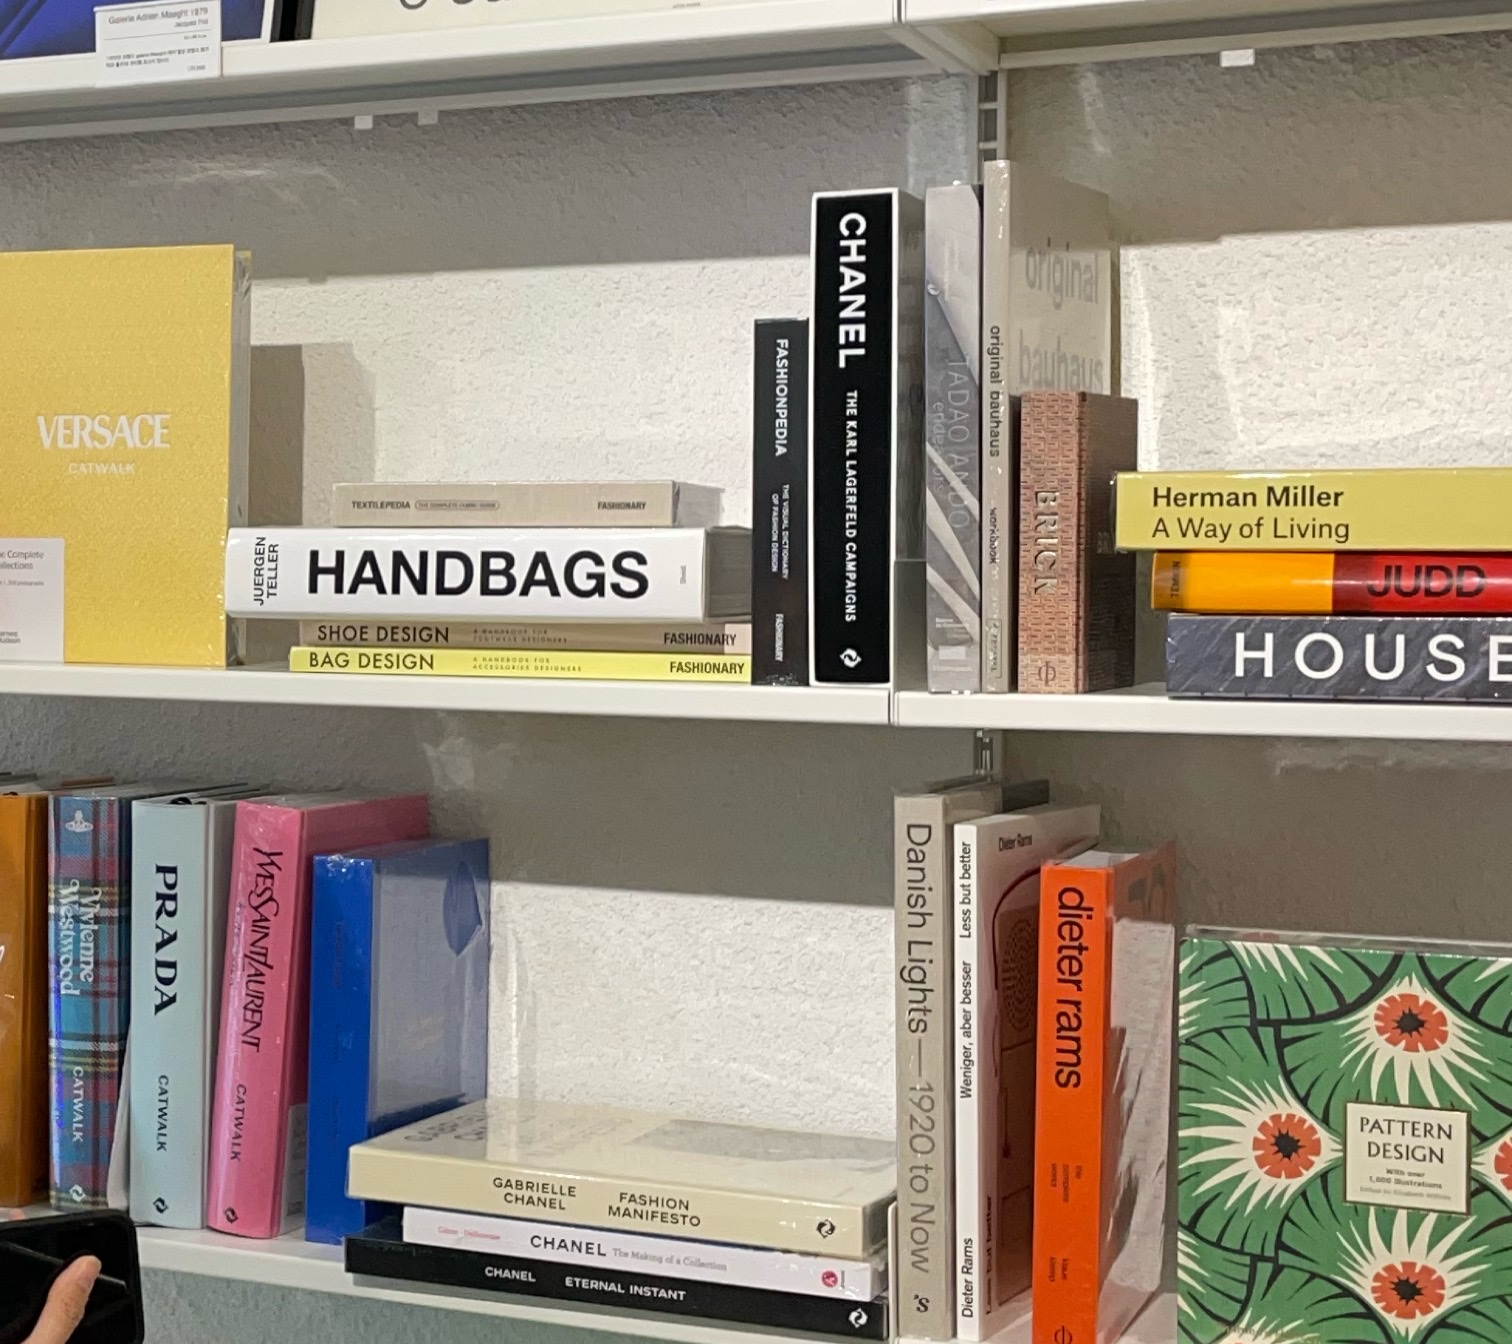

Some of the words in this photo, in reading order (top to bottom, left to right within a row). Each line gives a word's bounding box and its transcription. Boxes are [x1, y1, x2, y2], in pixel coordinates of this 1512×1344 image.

[838, 211, 867, 369] CHANEL
[989, 325, 1004, 384] original
[775, 339, 789, 457] FASHIONPEDIA
[846, 390, 858, 416] THE
[37, 413, 172, 449] VERSACE
[846, 420, 858, 457] KARL
[989, 390, 1001, 458] bauhaus
[68, 462, 136, 475] CATWALK
[352, 500, 411, 510] TEXTILEPEDIA
[598, 501, 647, 510] FASHIONARY
[845, 461, 858, 538] LAGERFELD
[1152, 486, 1257, 508] Herman
[1267, 485, 1344, 508] Miller
[1034, 490, 1060, 596] BRICK
[1152, 518, 1170, 538] A
[1177, 518, 1232, 543] Way
[1239, 517, 1264, 538] of
[1273, 517, 1350, 543] Living
[7, 549, 45, 561] Complete
[253, 536, 267, 606] JUERGEN
[267, 543, 279, 599] TELLER
[308, 549, 649, 599] HANDBAGS
[844, 543, 857, 622] CAMPAIGNS
[1367, 564, 1486, 598] JUDD
[317, 625, 369, 642] SHOE
[377, 626, 449, 643] DESIGN
[664, 632, 737, 647] FASHIONARY
[309, 651, 350, 669] BAG
[358, 653, 434, 671] DESIGN
[669, 661, 745, 674] FASHIONARY
[905, 823, 932, 929] Danish
[959, 841, 972, 880] better
[959, 883, 972, 905] but
[59, 878, 81, 996] Westwood
[79, 886, 102, 984] Vivienne
[154, 863, 179, 1017] PRADA
[959, 908, 972, 939] Less
[1057, 885, 1094, 991] dieter
[959, 961, 972, 1005] besser
[960, 1009, 972, 1039] aber
[1054, 998, 1082, 1089] rams
[959, 1042, 974, 1099] Weniger,
[71, 1065, 84, 1143] CATWALK
[156, 1074, 170, 1153] CATWALK
[231, 1083, 247, 1162] CATWALK
[1360, 1116, 1452, 1140] PATTERN
[1368, 1141, 1444, 1164] DESIGN
[493, 1176, 577, 1198] GABRIELLE
[619, 1191, 691, 1211] FASHION
[908, 1162, 936, 1195] to
[504, 1192, 566, 1211] CHANEL
[608, 1205, 701, 1228] MANIFESTO
[530, 1234, 607, 1257] CHANEL
[612, 1247, 629, 1259] The
[631, 1250, 664, 1265] Making
[682, 1256, 727, 1272] Collection
[909, 1202, 936, 1273] Now
[960, 1238, 973, 1275] Rams
[484, 1266, 536, 1283] CHANEL
[565, 1277, 626, 1294] ETERNAL
[629, 1284, 686, 1302] INSTANT
[960, 1278, 974, 1318] Dieter
